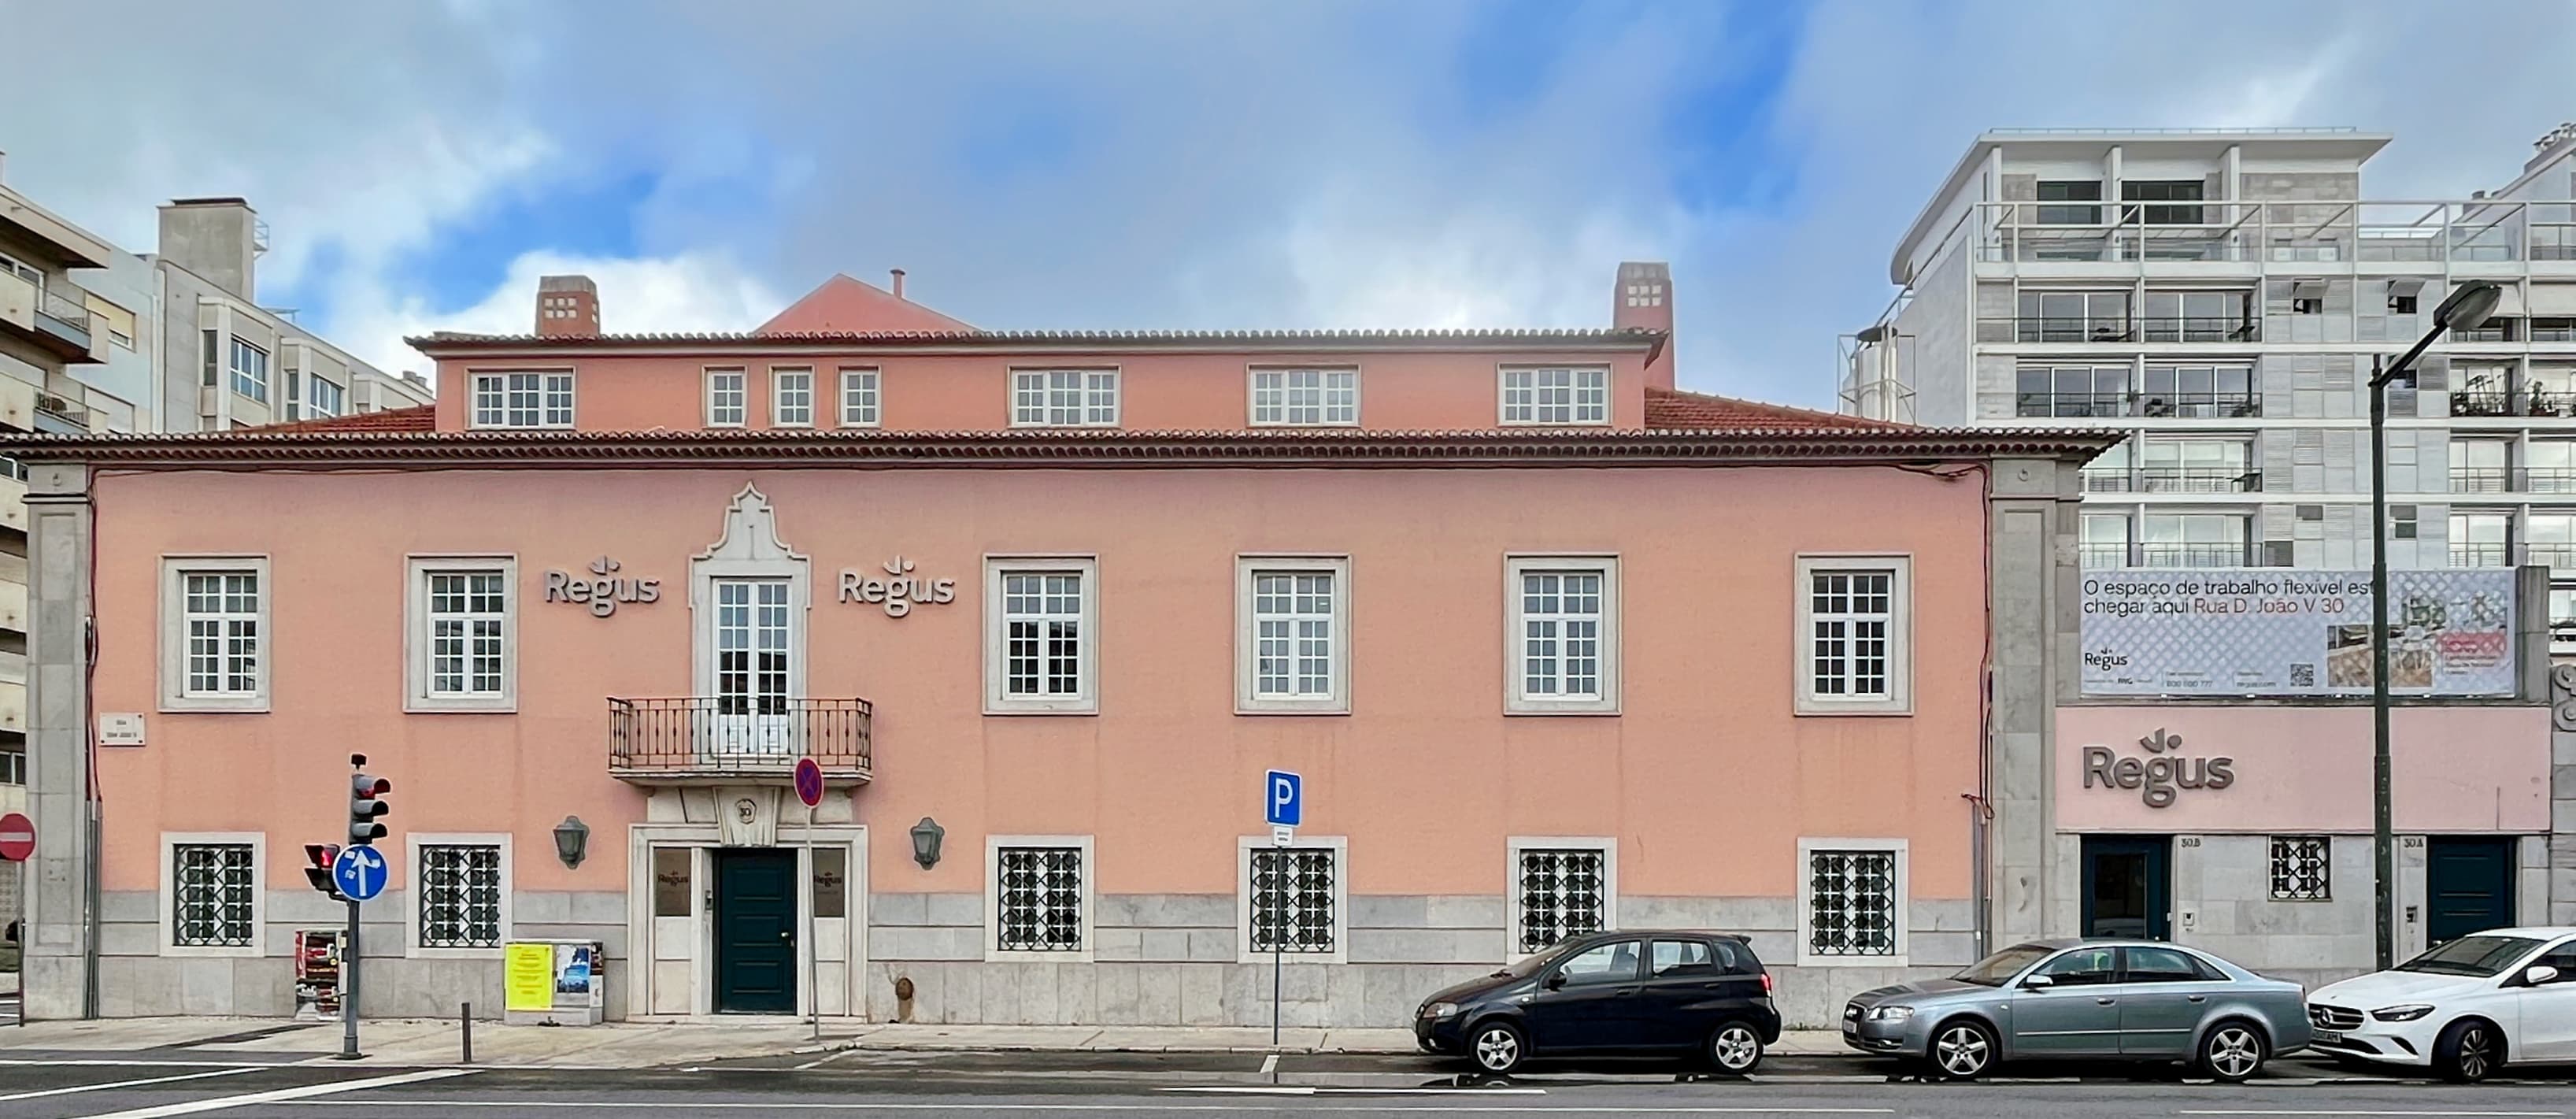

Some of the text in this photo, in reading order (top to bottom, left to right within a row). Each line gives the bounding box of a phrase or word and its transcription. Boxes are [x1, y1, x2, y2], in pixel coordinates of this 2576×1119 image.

[544, 565, 660, 617] Regus
[838, 565, 955, 617] Regus
[2084, 580, 2098, 595] O
[2104, 582, 2170, 598] espaço
[2176, 580, 2199, 595] de
[2204, 579, 2278, 595] trabalho
[2084, 598, 2145, 617] chegar
[2152, 598, 2189, 615] aqui
[2194, 598, 2229, 613] Rua
[2256, 598, 2298, 613] João
[2304, 598, 2316, 613] V
[2322, 598, 2345, 613] 30
[2085, 651, 2128, 671] Regus
[2082, 742, 2234, 809] Regus
[1275, 778, 1294, 818] P
[740, 807, 751, 817] 30
[658, 873, 688, 887] Regus
